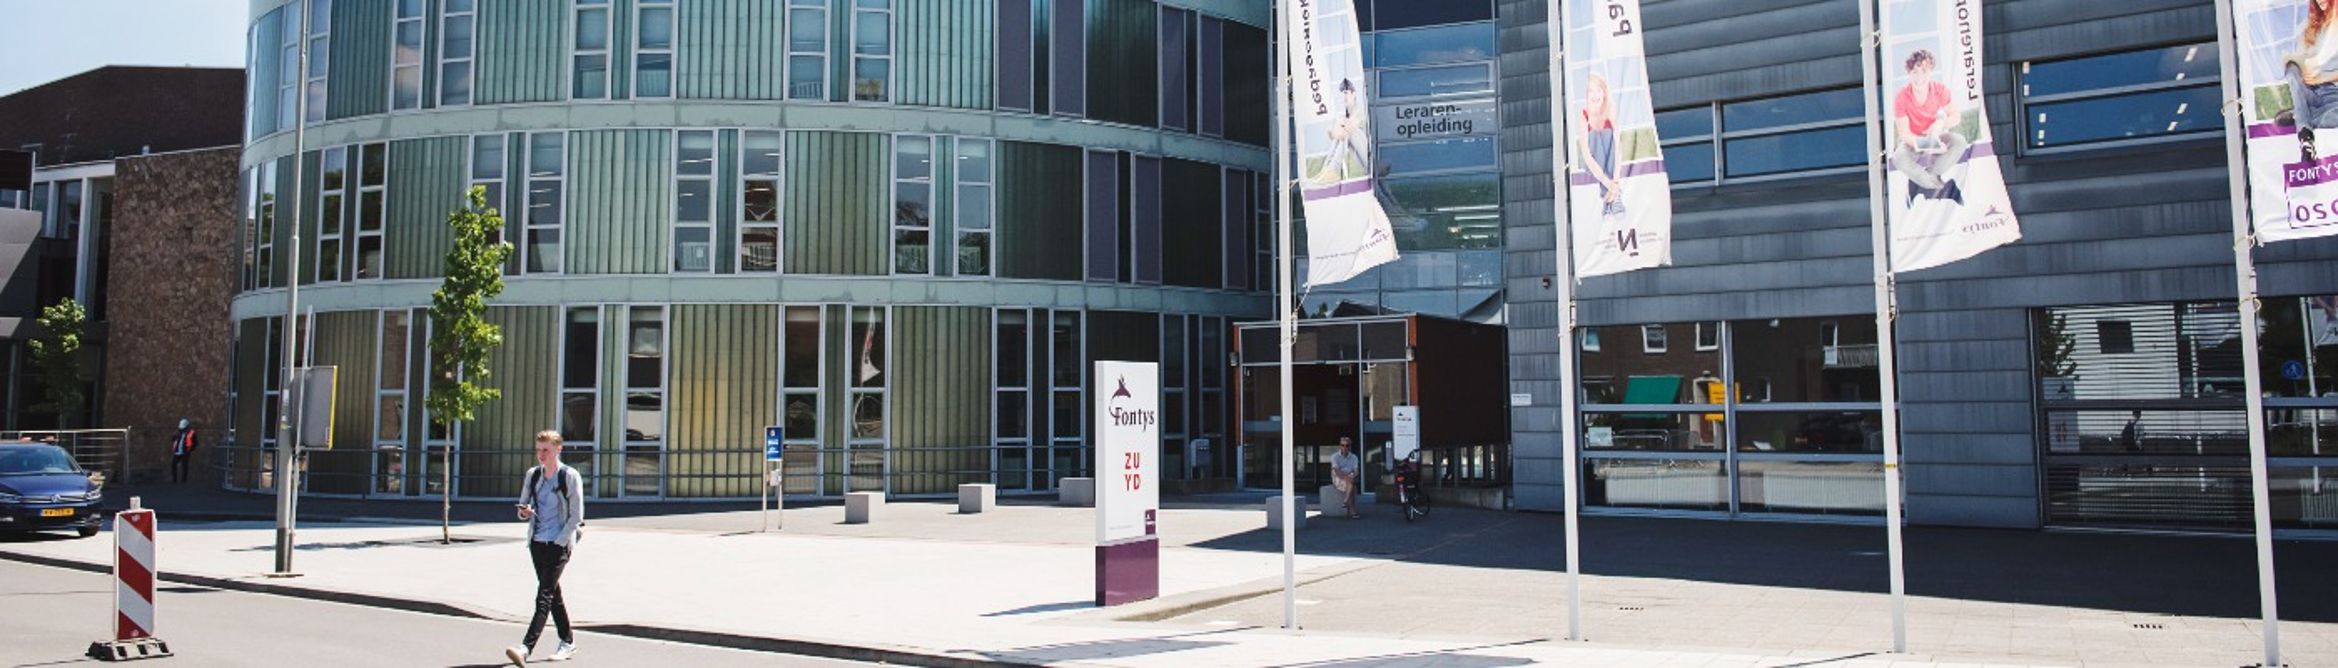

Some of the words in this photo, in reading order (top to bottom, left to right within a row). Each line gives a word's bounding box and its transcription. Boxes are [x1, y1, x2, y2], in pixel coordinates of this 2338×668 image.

[1396, 104, 1461, 119] Leraren-
[1397, 118, 1472, 138] opleiding
[2289, 162, 2338, 182] FONTYS
[1109, 405, 1154, 431] Fontys
[1125, 452, 1140, 470] ZU
[1124, 473, 1141, 491] YD
